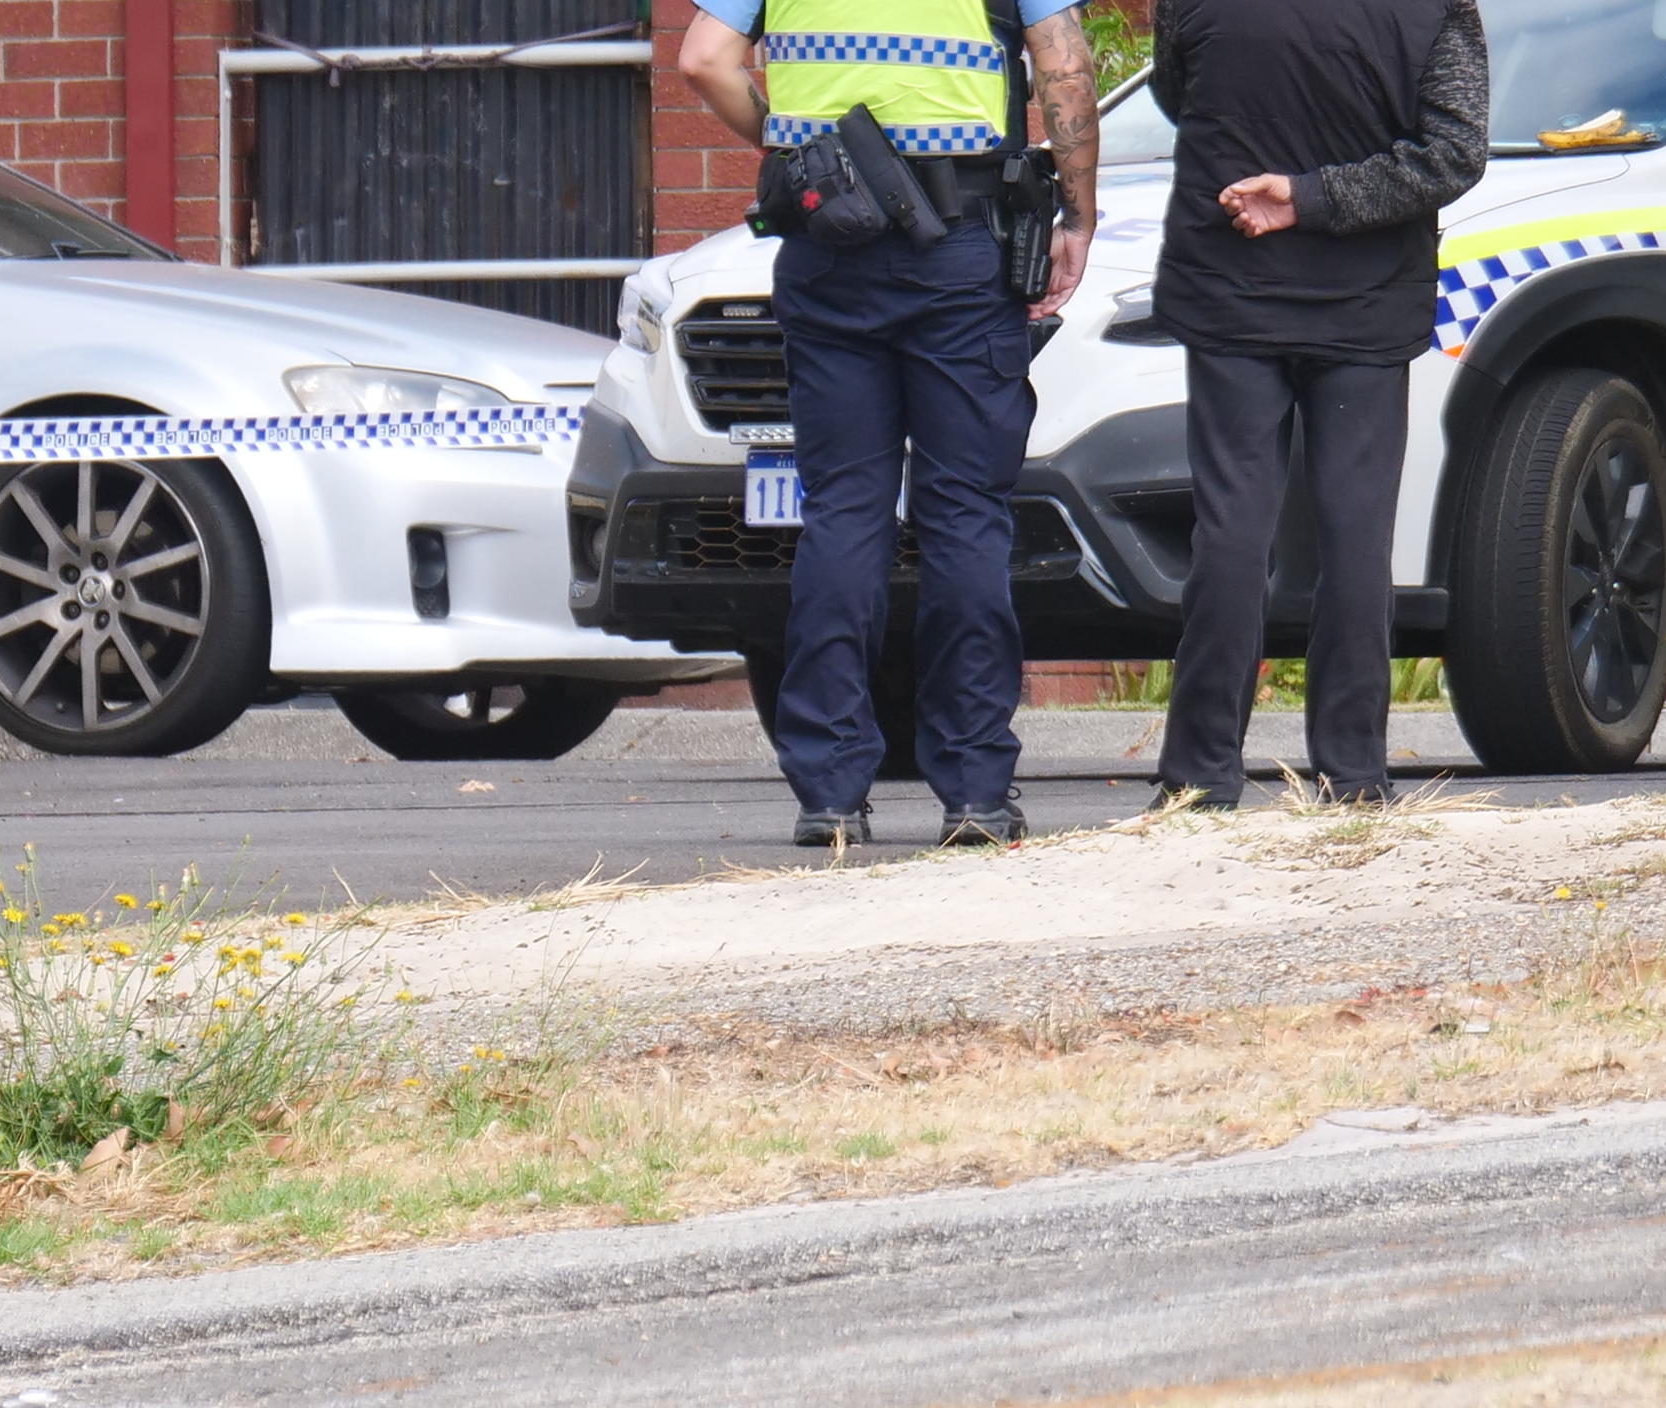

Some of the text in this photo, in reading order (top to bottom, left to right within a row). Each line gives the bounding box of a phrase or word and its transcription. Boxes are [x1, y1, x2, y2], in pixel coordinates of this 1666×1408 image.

[44, 433, 110, 447] POLICE
[266, 426, 333, 441] POLICE
[489, 419, 555, 434] POLICE
